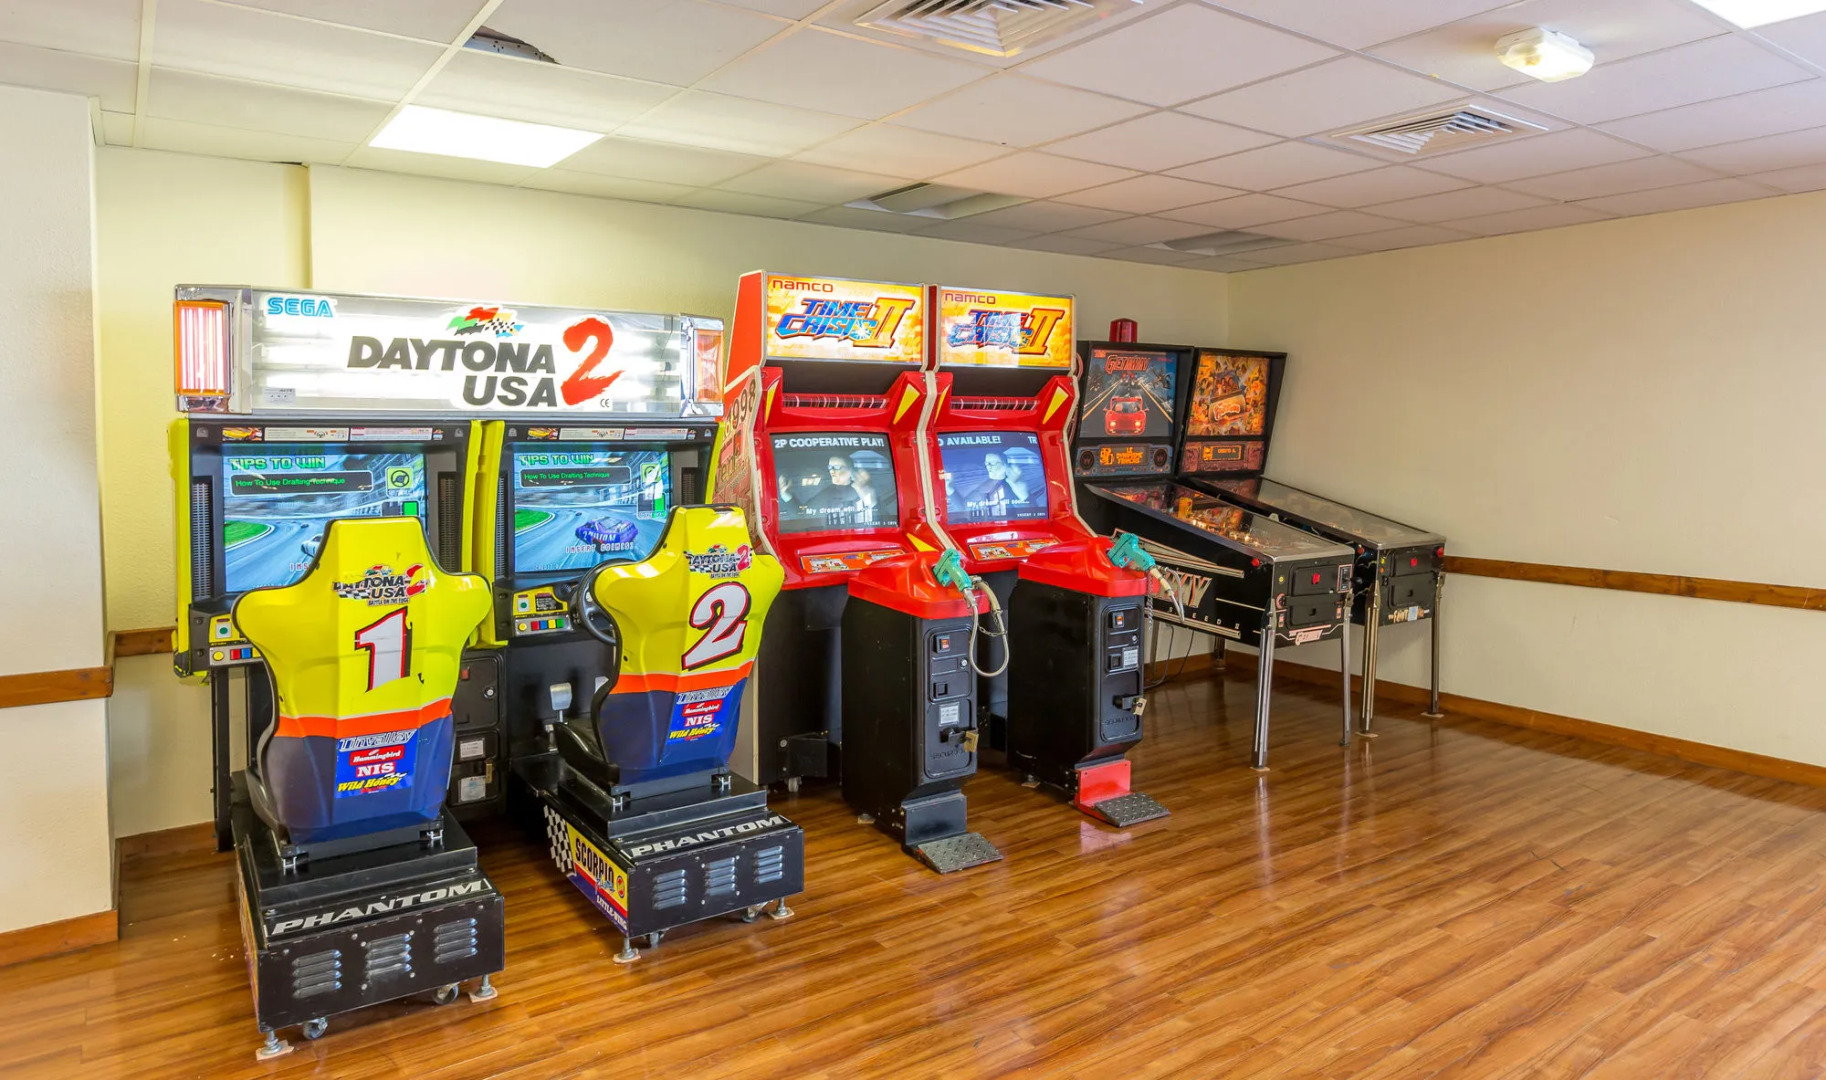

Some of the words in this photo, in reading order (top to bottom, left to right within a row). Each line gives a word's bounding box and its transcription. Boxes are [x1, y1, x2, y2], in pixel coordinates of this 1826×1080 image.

[772, 279, 834, 293] namco
[267, 297, 334, 318] SEGA
[801, 297, 872, 318] TIME
[944, 292, 996, 305] namco
[775, 313, 878, 341] CRISIS
[853, 297, 916, 349] II
[969, 308, 1030, 327] TIME
[947, 323, 1034, 348] CRISIS
[1012, 307, 1065, 355] II
[347, 336, 556, 373] DAYTONA
[561, 314, 626, 407] 2
[461, 374, 558, 408] USA
[774, 438, 788, 449] 2P
[789, 437, 860, 448] COOPERATIVE
[861, 437, 884, 447] PLAY!
[946, 436, 1002, 446] AVAILABLE!
[229, 456, 267, 471] TIPS
[270, 456, 292, 470] TO
[294, 456, 326, 469] WIN
[519, 454, 550, 466] TIPS
[552, 454, 570, 465] TO
[235, 479, 253, 487] How
[254, 479, 264, 487] To
[282, 477, 311, 487] Drafting
[560, 472, 583, 480] Drafting
[584, 471, 610, 479] Technique
[806, 508, 817, 516] My
[737, 544, 750, 571] 2
[712, 563, 737, 573] USA
[371, 586, 405, 599] USA
[681, 580, 751, 671] 2
[354, 605, 412, 693] 1
[685, 714, 713, 727] NIS
[669, 729, 690, 739] Wild
[357, 762, 395, 777] NIS
[337, 780, 365, 792] Wild
[364, 776, 400, 788] Honey
[630, 815, 784, 857] PHANTOM
[575, 837, 615, 886] SCORPIO
[271, 879, 483, 935] PHANTOM
